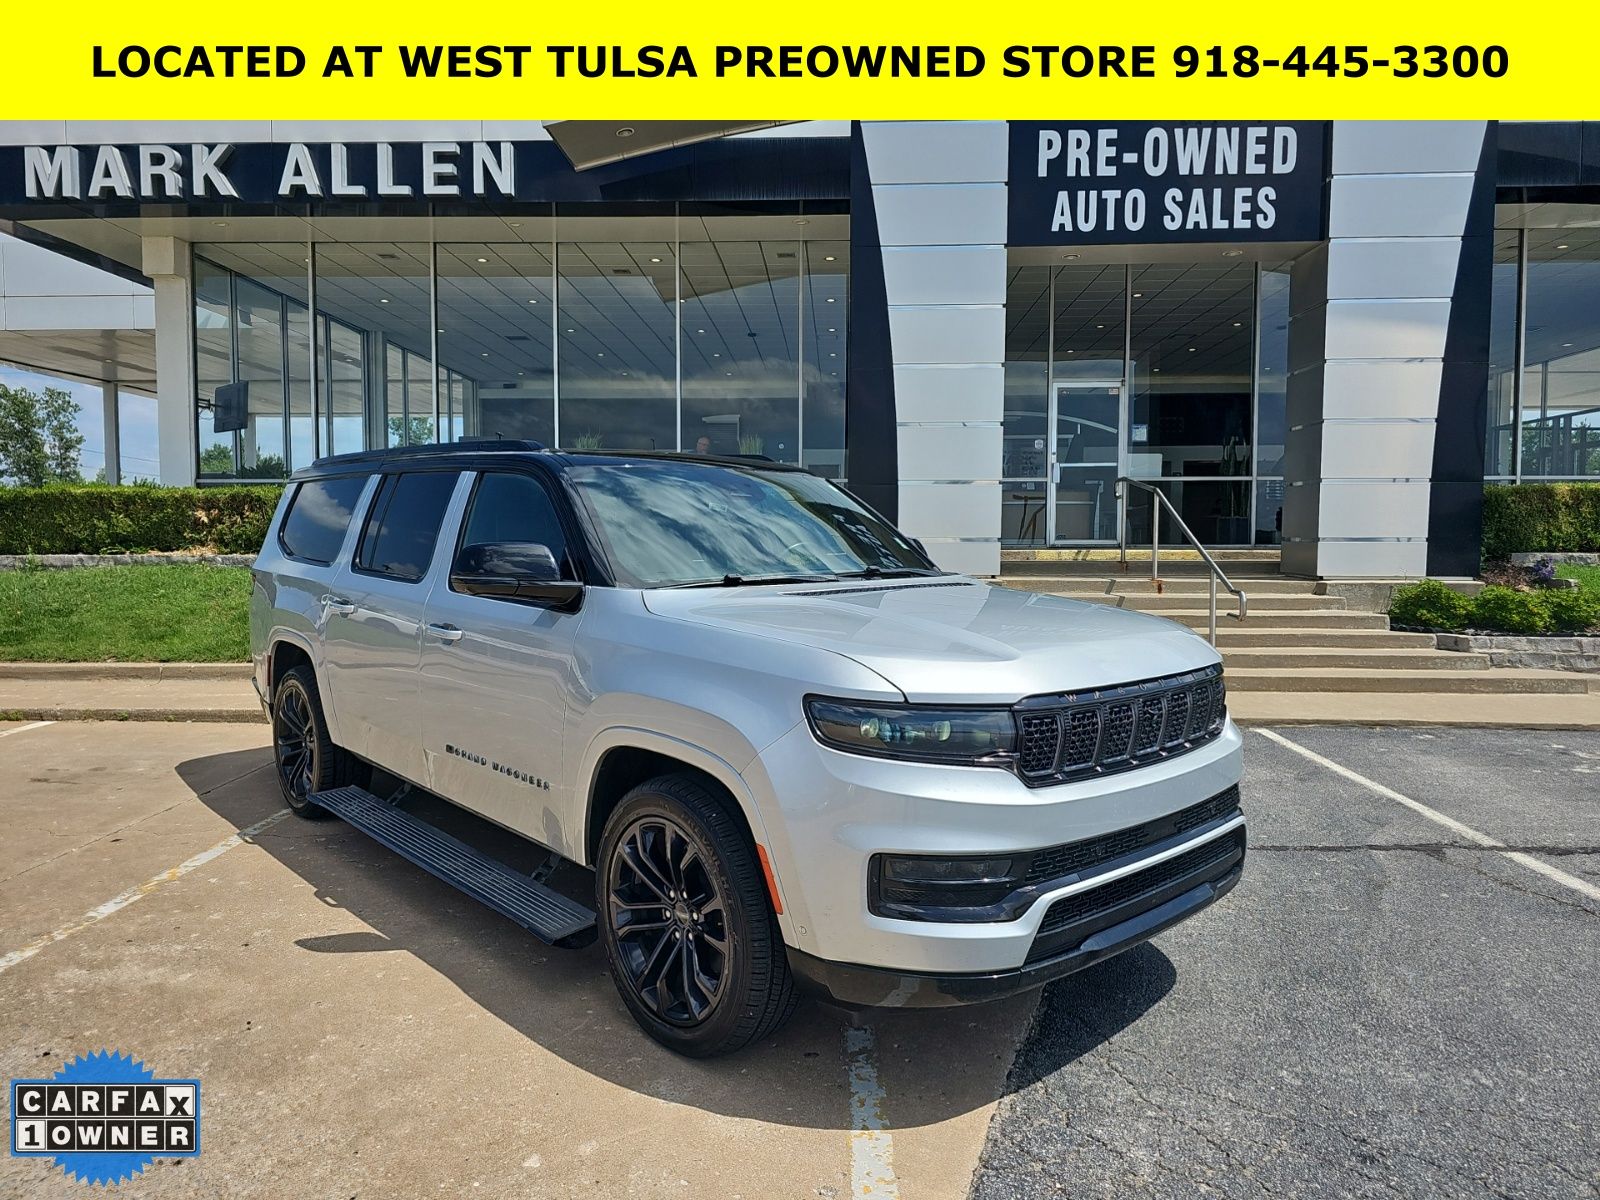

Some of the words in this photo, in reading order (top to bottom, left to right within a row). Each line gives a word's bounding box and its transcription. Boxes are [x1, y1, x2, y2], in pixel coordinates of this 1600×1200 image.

[24, 144, 240, 199] MARK
[277, 142, 516, 198] ALLEN
[1037, 126, 1298, 178] PRE-OWNED
[1051, 188, 1146, 232] AUTO
[1163, 186, 1277, 230] SALES
[454, 747, 487, 766] GRAND
[491, 761, 550, 792] WAGONEER
